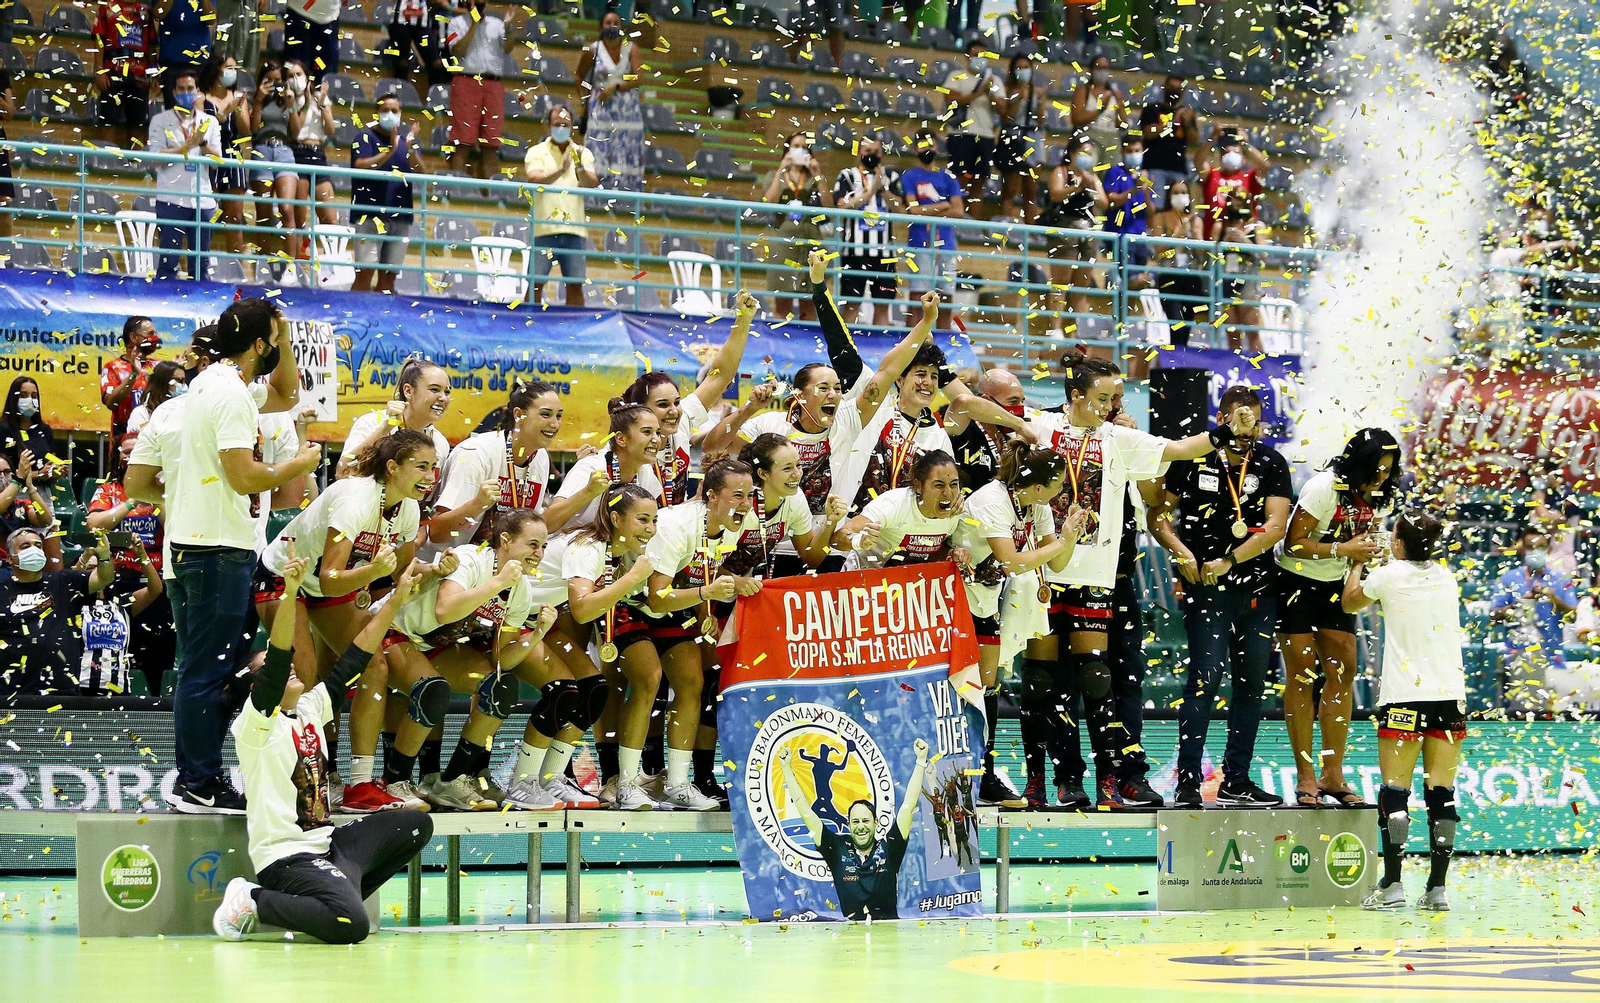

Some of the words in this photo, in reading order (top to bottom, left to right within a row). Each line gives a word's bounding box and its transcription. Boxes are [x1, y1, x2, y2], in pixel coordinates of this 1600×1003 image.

[63, 355, 89, 374] de
[292, 344, 328, 367] OPA!!
[467, 344, 571, 375] Deportes
[370, 369, 396, 389] Ayt
[449, 373, 482, 390] urín
[488, 374, 508, 391] de
[783, 574, 955, 642] CAMPEONAS
[787, 640, 829, 669] COPA
[832, 635, 867, 665] S.M.
[869, 635, 886, 664] LA
[887, 628, 936, 661] REINA
[755, 706, 835, 756] BALONMANO
[837, 716, 891, 793] FEMENINO
[749, 757, 762, 803] CLUB
[758, 815, 803, 873] MÁLAGA
[1279, 846, 1286, 858] F
[1346, 843, 1360, 851] LIGA
[132, 858, 149, 867] LIGA
[1291, 852, 1309, 867] BM
[110, 867, 152, 876] GUERRERAS
[112, 876, 152, 886] IBERDROLA
[1202, 878, 1221, 886] Junta
[1221, 877, 1230, 886] de
[1230, 875, 1263, 886] Andalucía
[1159, 878, 1167, 886] de
[1167, 877, 1190, 887] málaga
